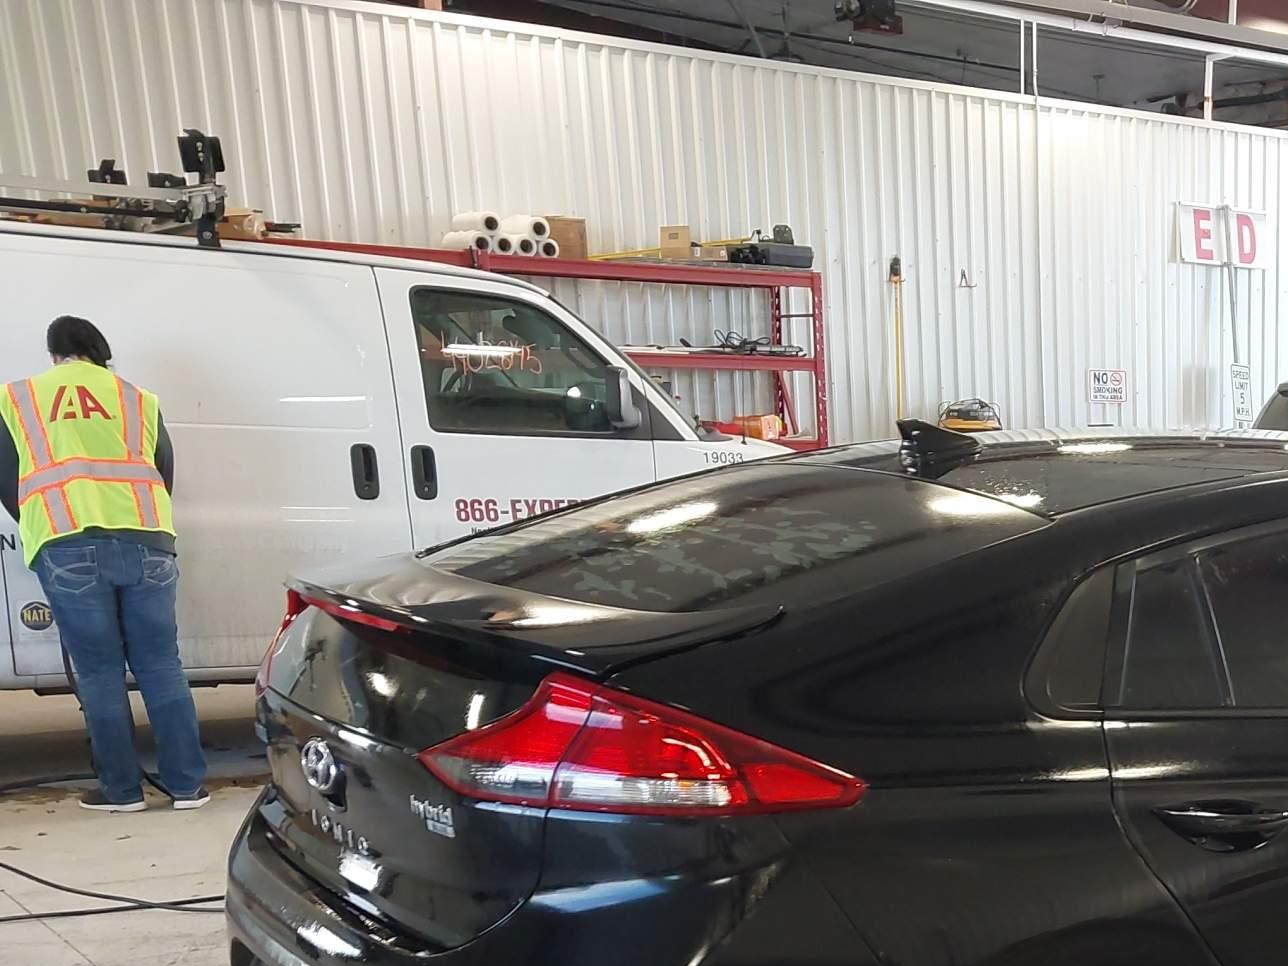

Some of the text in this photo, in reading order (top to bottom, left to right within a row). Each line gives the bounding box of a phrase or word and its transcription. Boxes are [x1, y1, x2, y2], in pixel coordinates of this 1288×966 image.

[1193, 208, 1214, 260] E
[1236, 213, 1257, 264] D
[1093, 371, 1109, 385] NO
[1234, 380, 1249, 391] LIMIT
[1239, 391, 1246, 405] 5
[703, 451, 744, 464] 19033
[22, 608, 51, 623] NATE
[410, 793, 454, 827] hybrid
[311, 808, 371, 856] IONIQ
